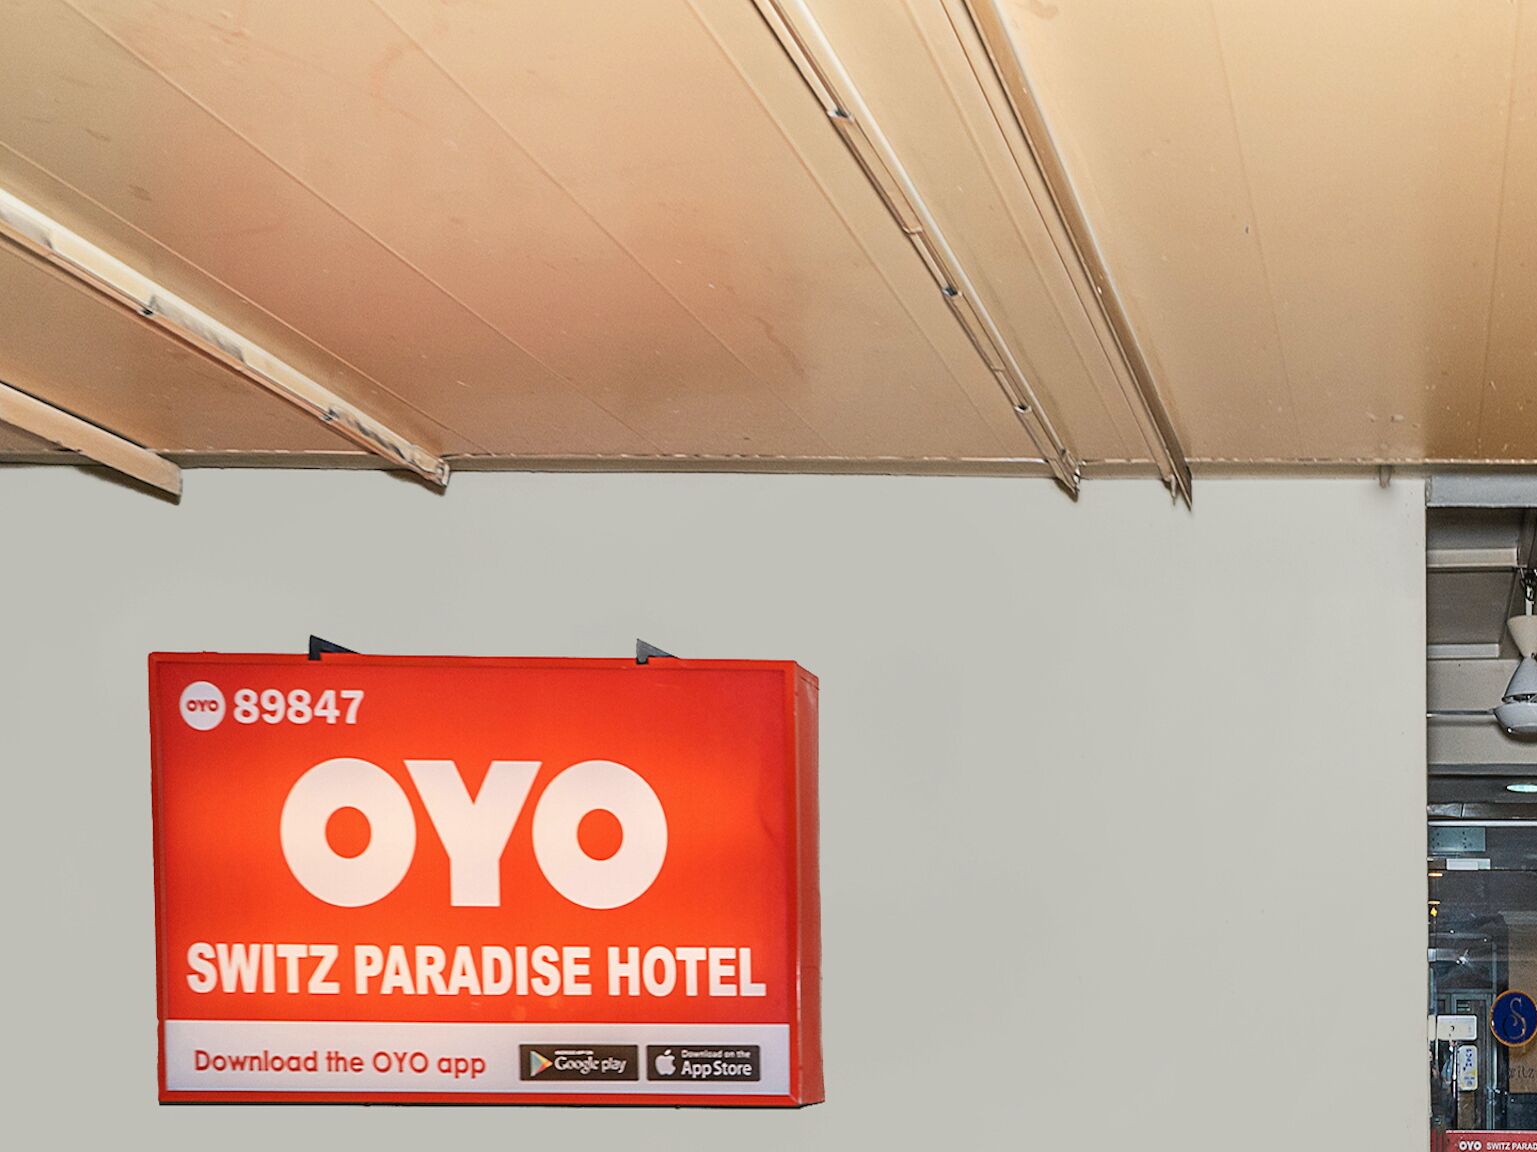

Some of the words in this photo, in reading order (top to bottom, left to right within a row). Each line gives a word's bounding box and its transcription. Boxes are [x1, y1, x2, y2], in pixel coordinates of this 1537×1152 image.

[186, 700, 219, 712] OYO
[233, 688, 365, 725] 89847
[280, 757, 668, 910] OYO
[186, 942, 341, 994] SWITZ
[354, 944, 592, 996] PARADISE
[607, 945, 767, 997] HOTEL
[681, 1049, 723, 1059] Download
[194, 1050, 318, 1072] Download
[326, 1051, 364, 1073] the
[372, 1051, 429, 1073] OYO
[437, 1057, 486, 1079] app
[554, 1056, 600, 1074] Google
[601, 1057, 627, 1074] play
[681, 1060, 713, 1078] App
[713, 1060, 752, 1076] Store
[1459, 1140, 1482, 1151] OYO
[1486, 1142, 1510, 1151] SWITZ
